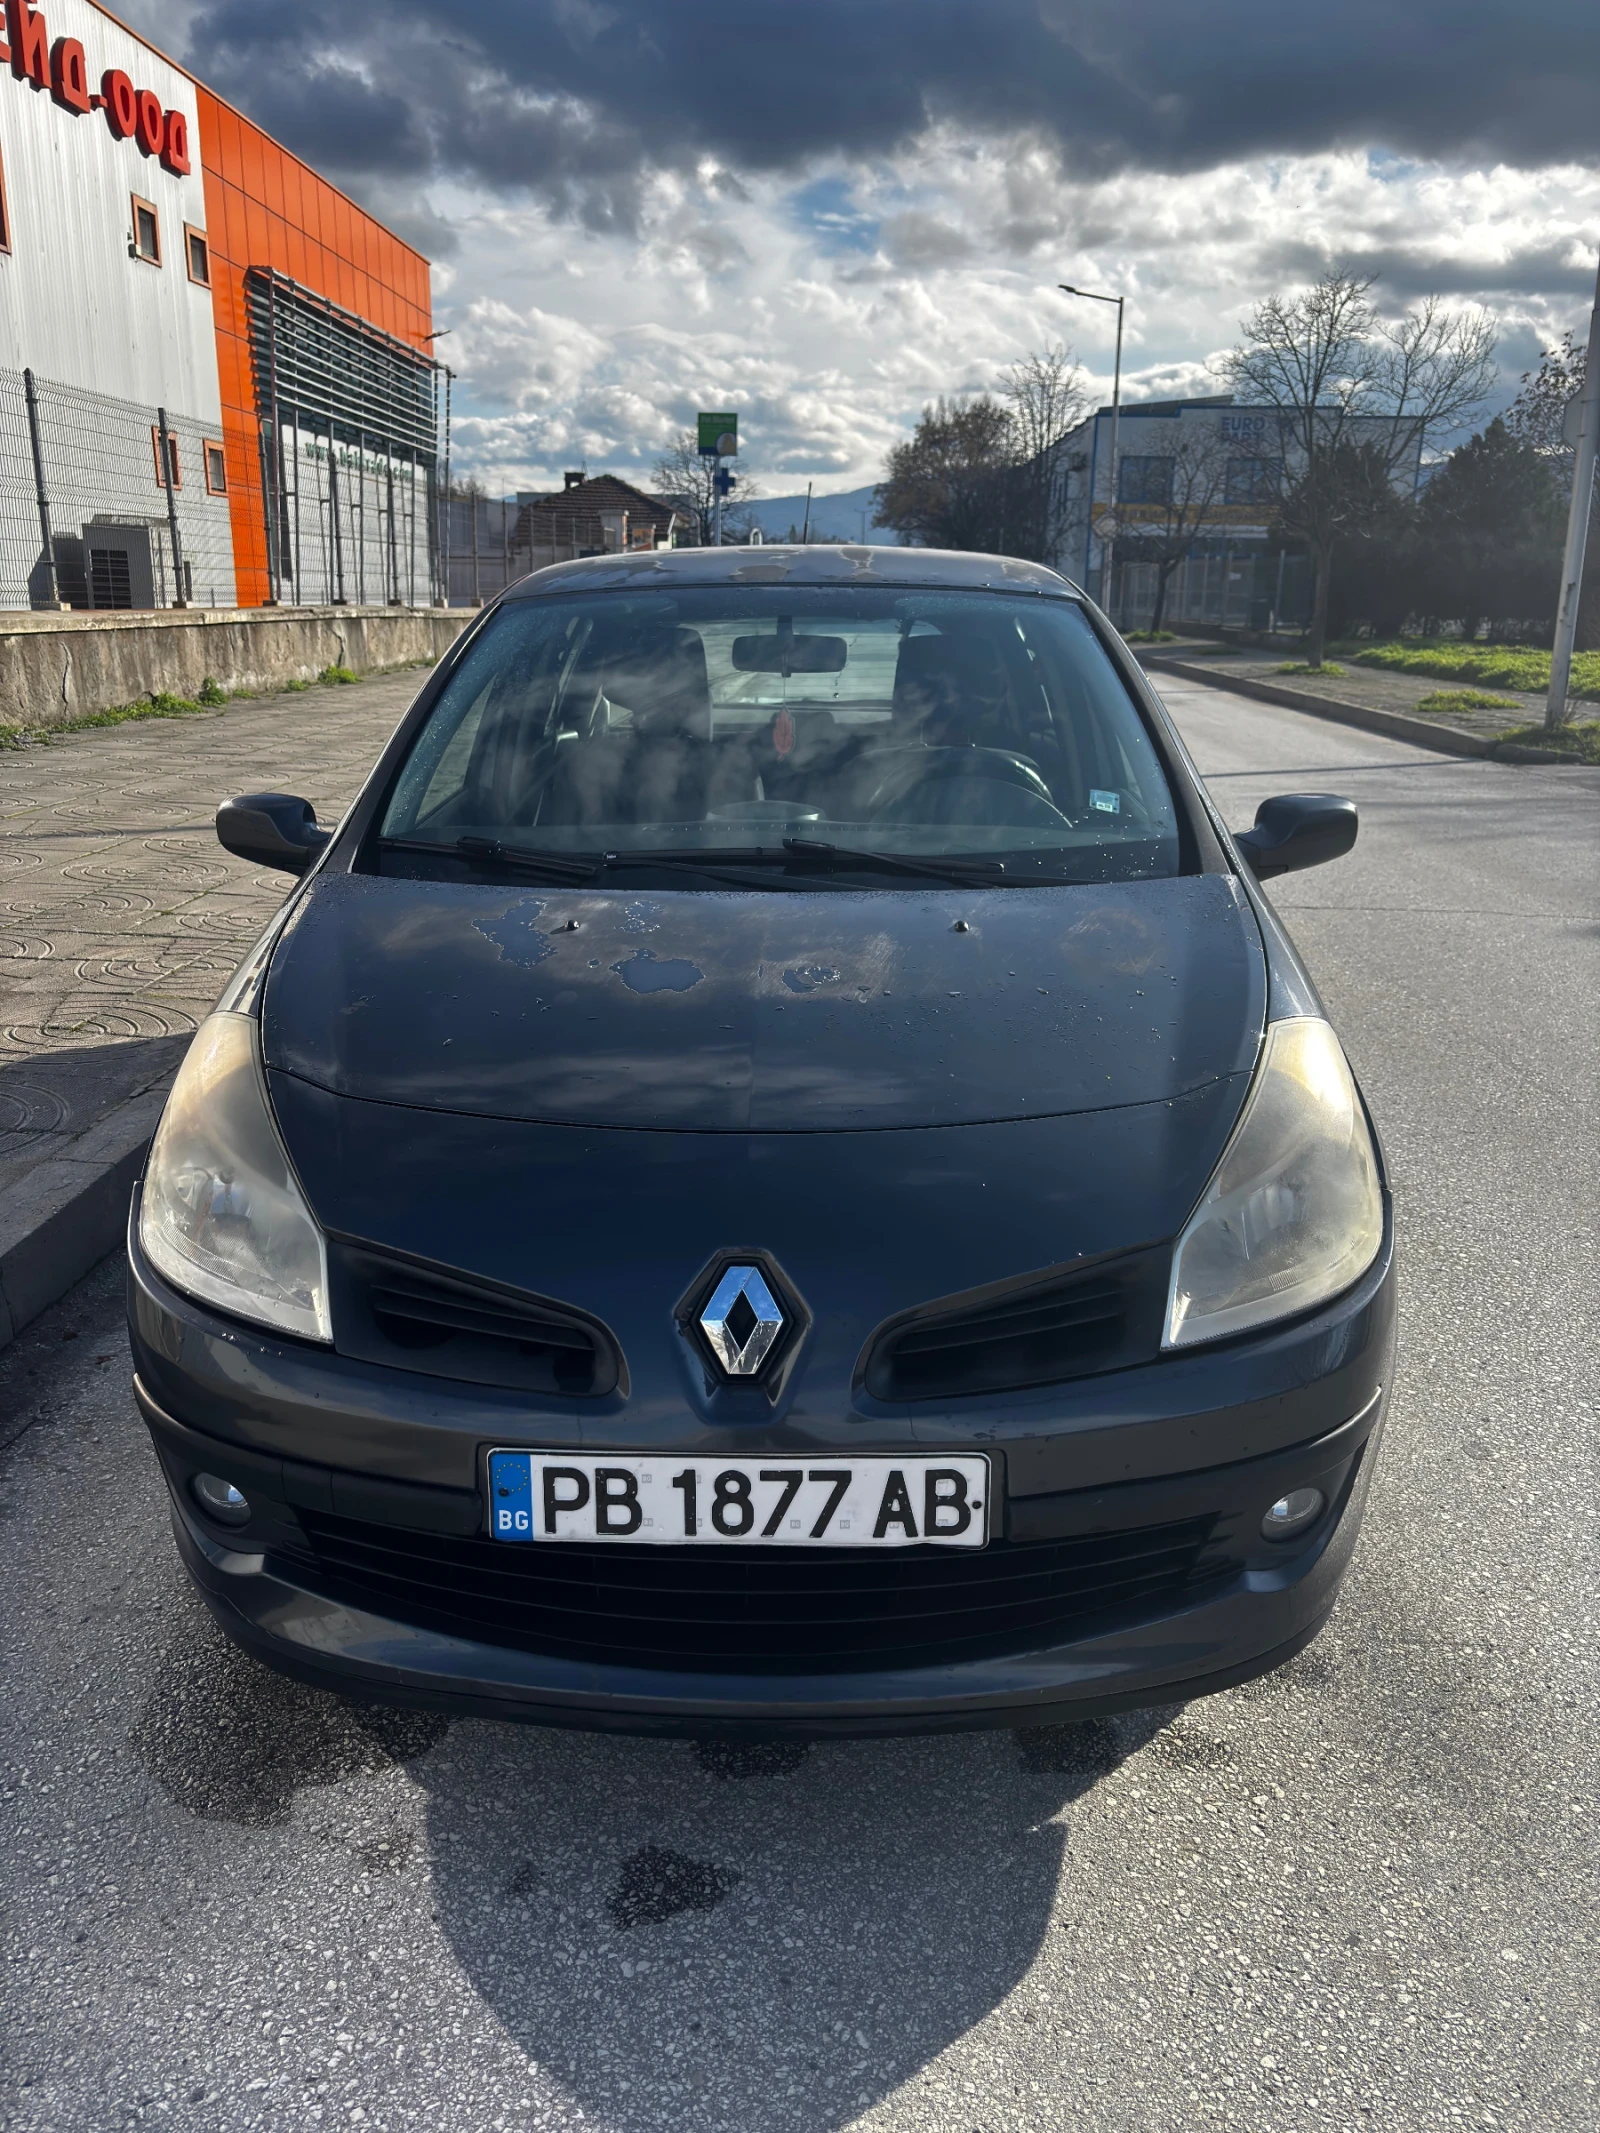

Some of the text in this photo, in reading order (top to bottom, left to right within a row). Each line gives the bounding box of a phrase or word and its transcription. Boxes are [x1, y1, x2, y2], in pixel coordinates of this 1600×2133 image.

[1221, 416, 1265, 431] EURO
[542, 1466, 971, 1538] PB 1877 AB
[498, 1509, 529, 1530] BG
